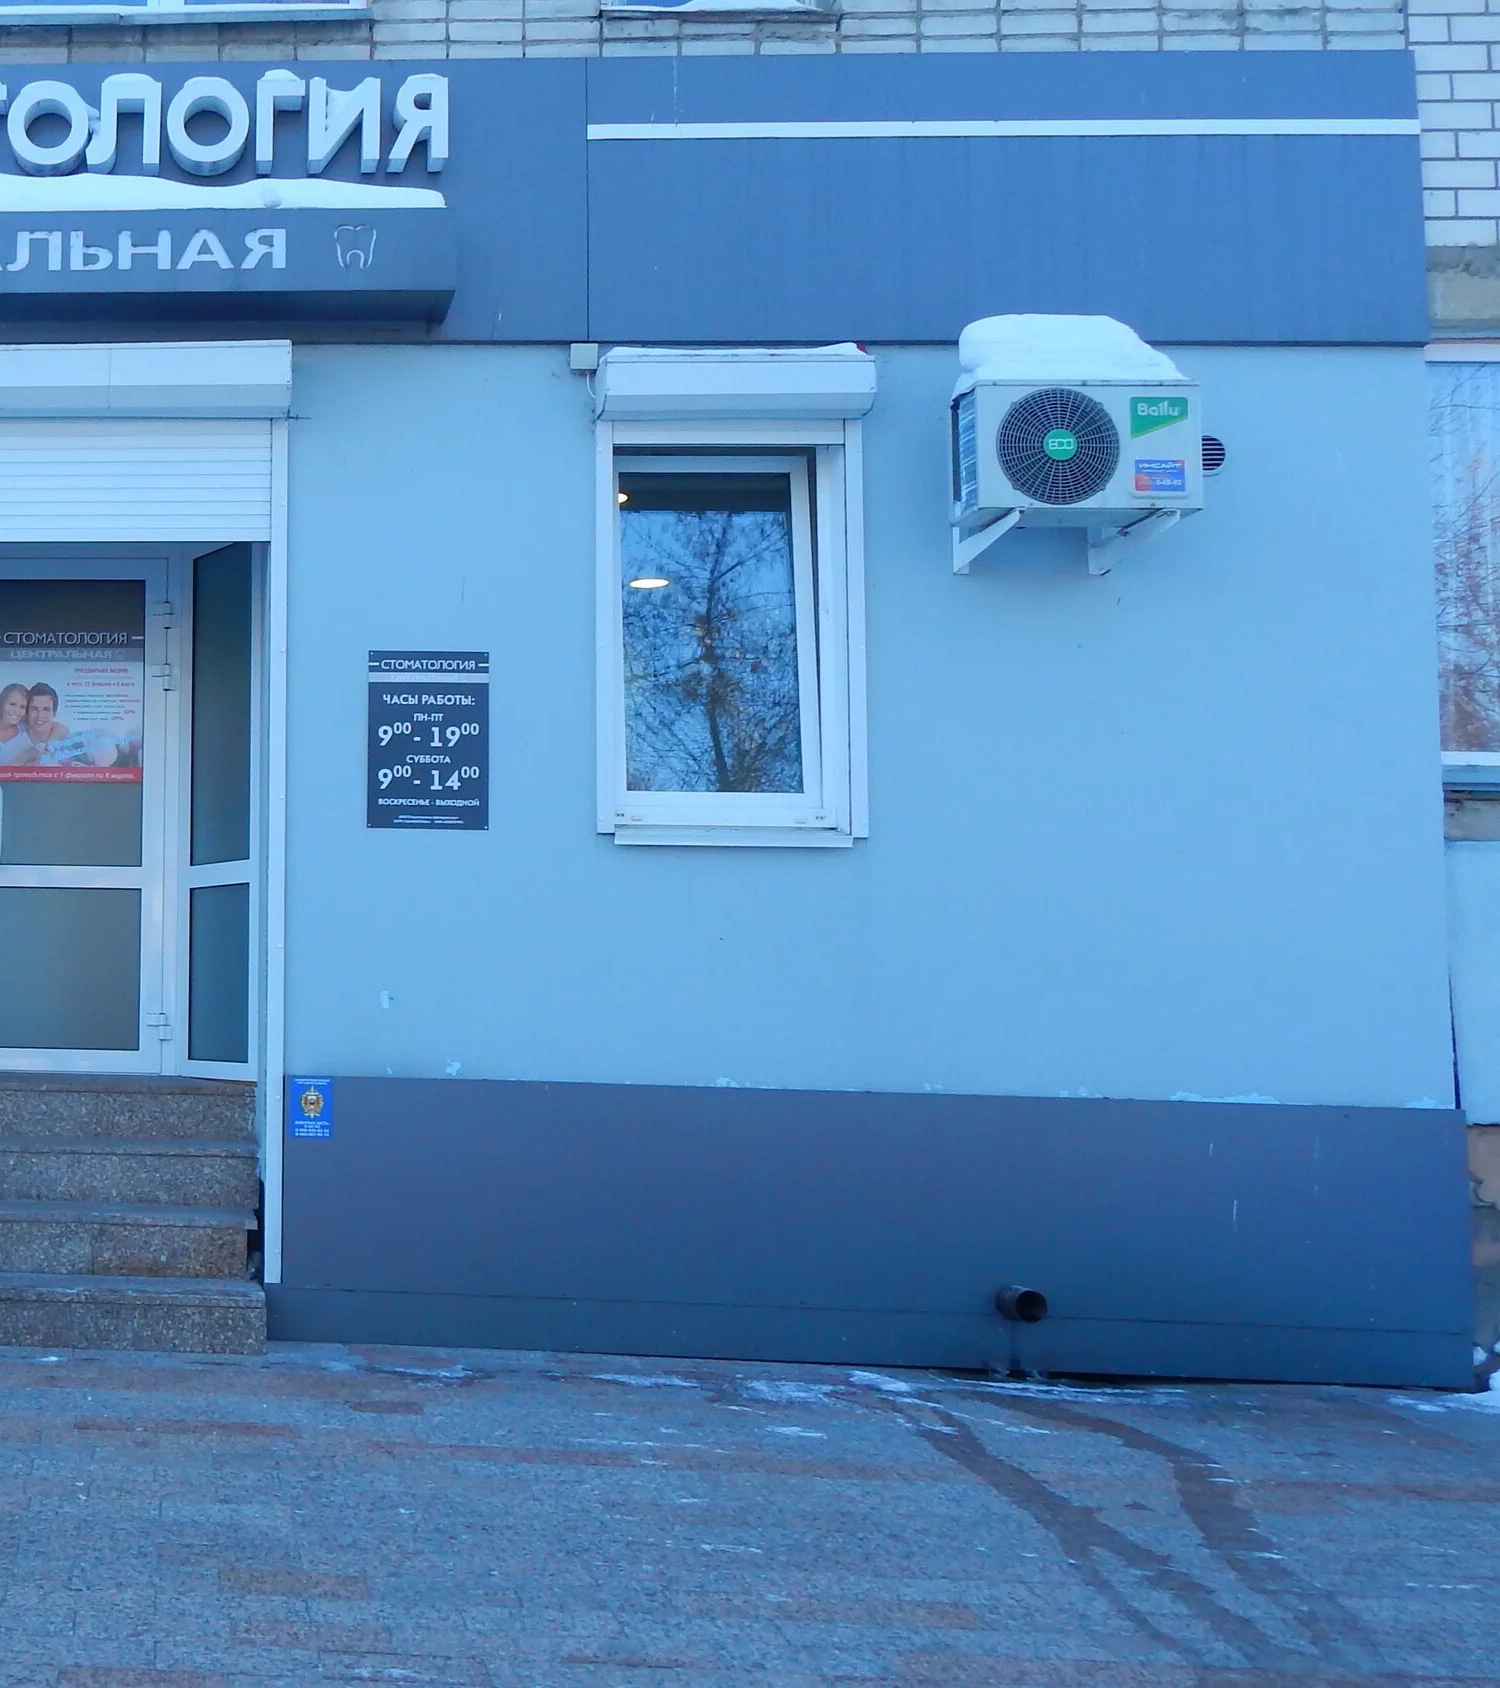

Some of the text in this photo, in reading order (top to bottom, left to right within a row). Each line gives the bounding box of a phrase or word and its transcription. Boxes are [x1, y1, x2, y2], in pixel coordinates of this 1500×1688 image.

[1137, 400, 1179, 416] Ballu
[4, 632, 128, 645] СТОМАТОЛОГИЯ
[11, 649, 112, 660] ЦЕНТРАЛЬНАЯ
[381, 660, 476, 670] СТОМАТОЛОГИЯ
[383, 694, 476, 705] ЧАСЫ РАБОТЫ:
[414, 713, 444, 722] ПН-ПТ
[406, 755, 451, 764] СУББОТА
[378, 798, 430, 806] ВОСКРЕСЕНЬЕ
[436, 798, 480, 807] ВЫХОДНОЙ
